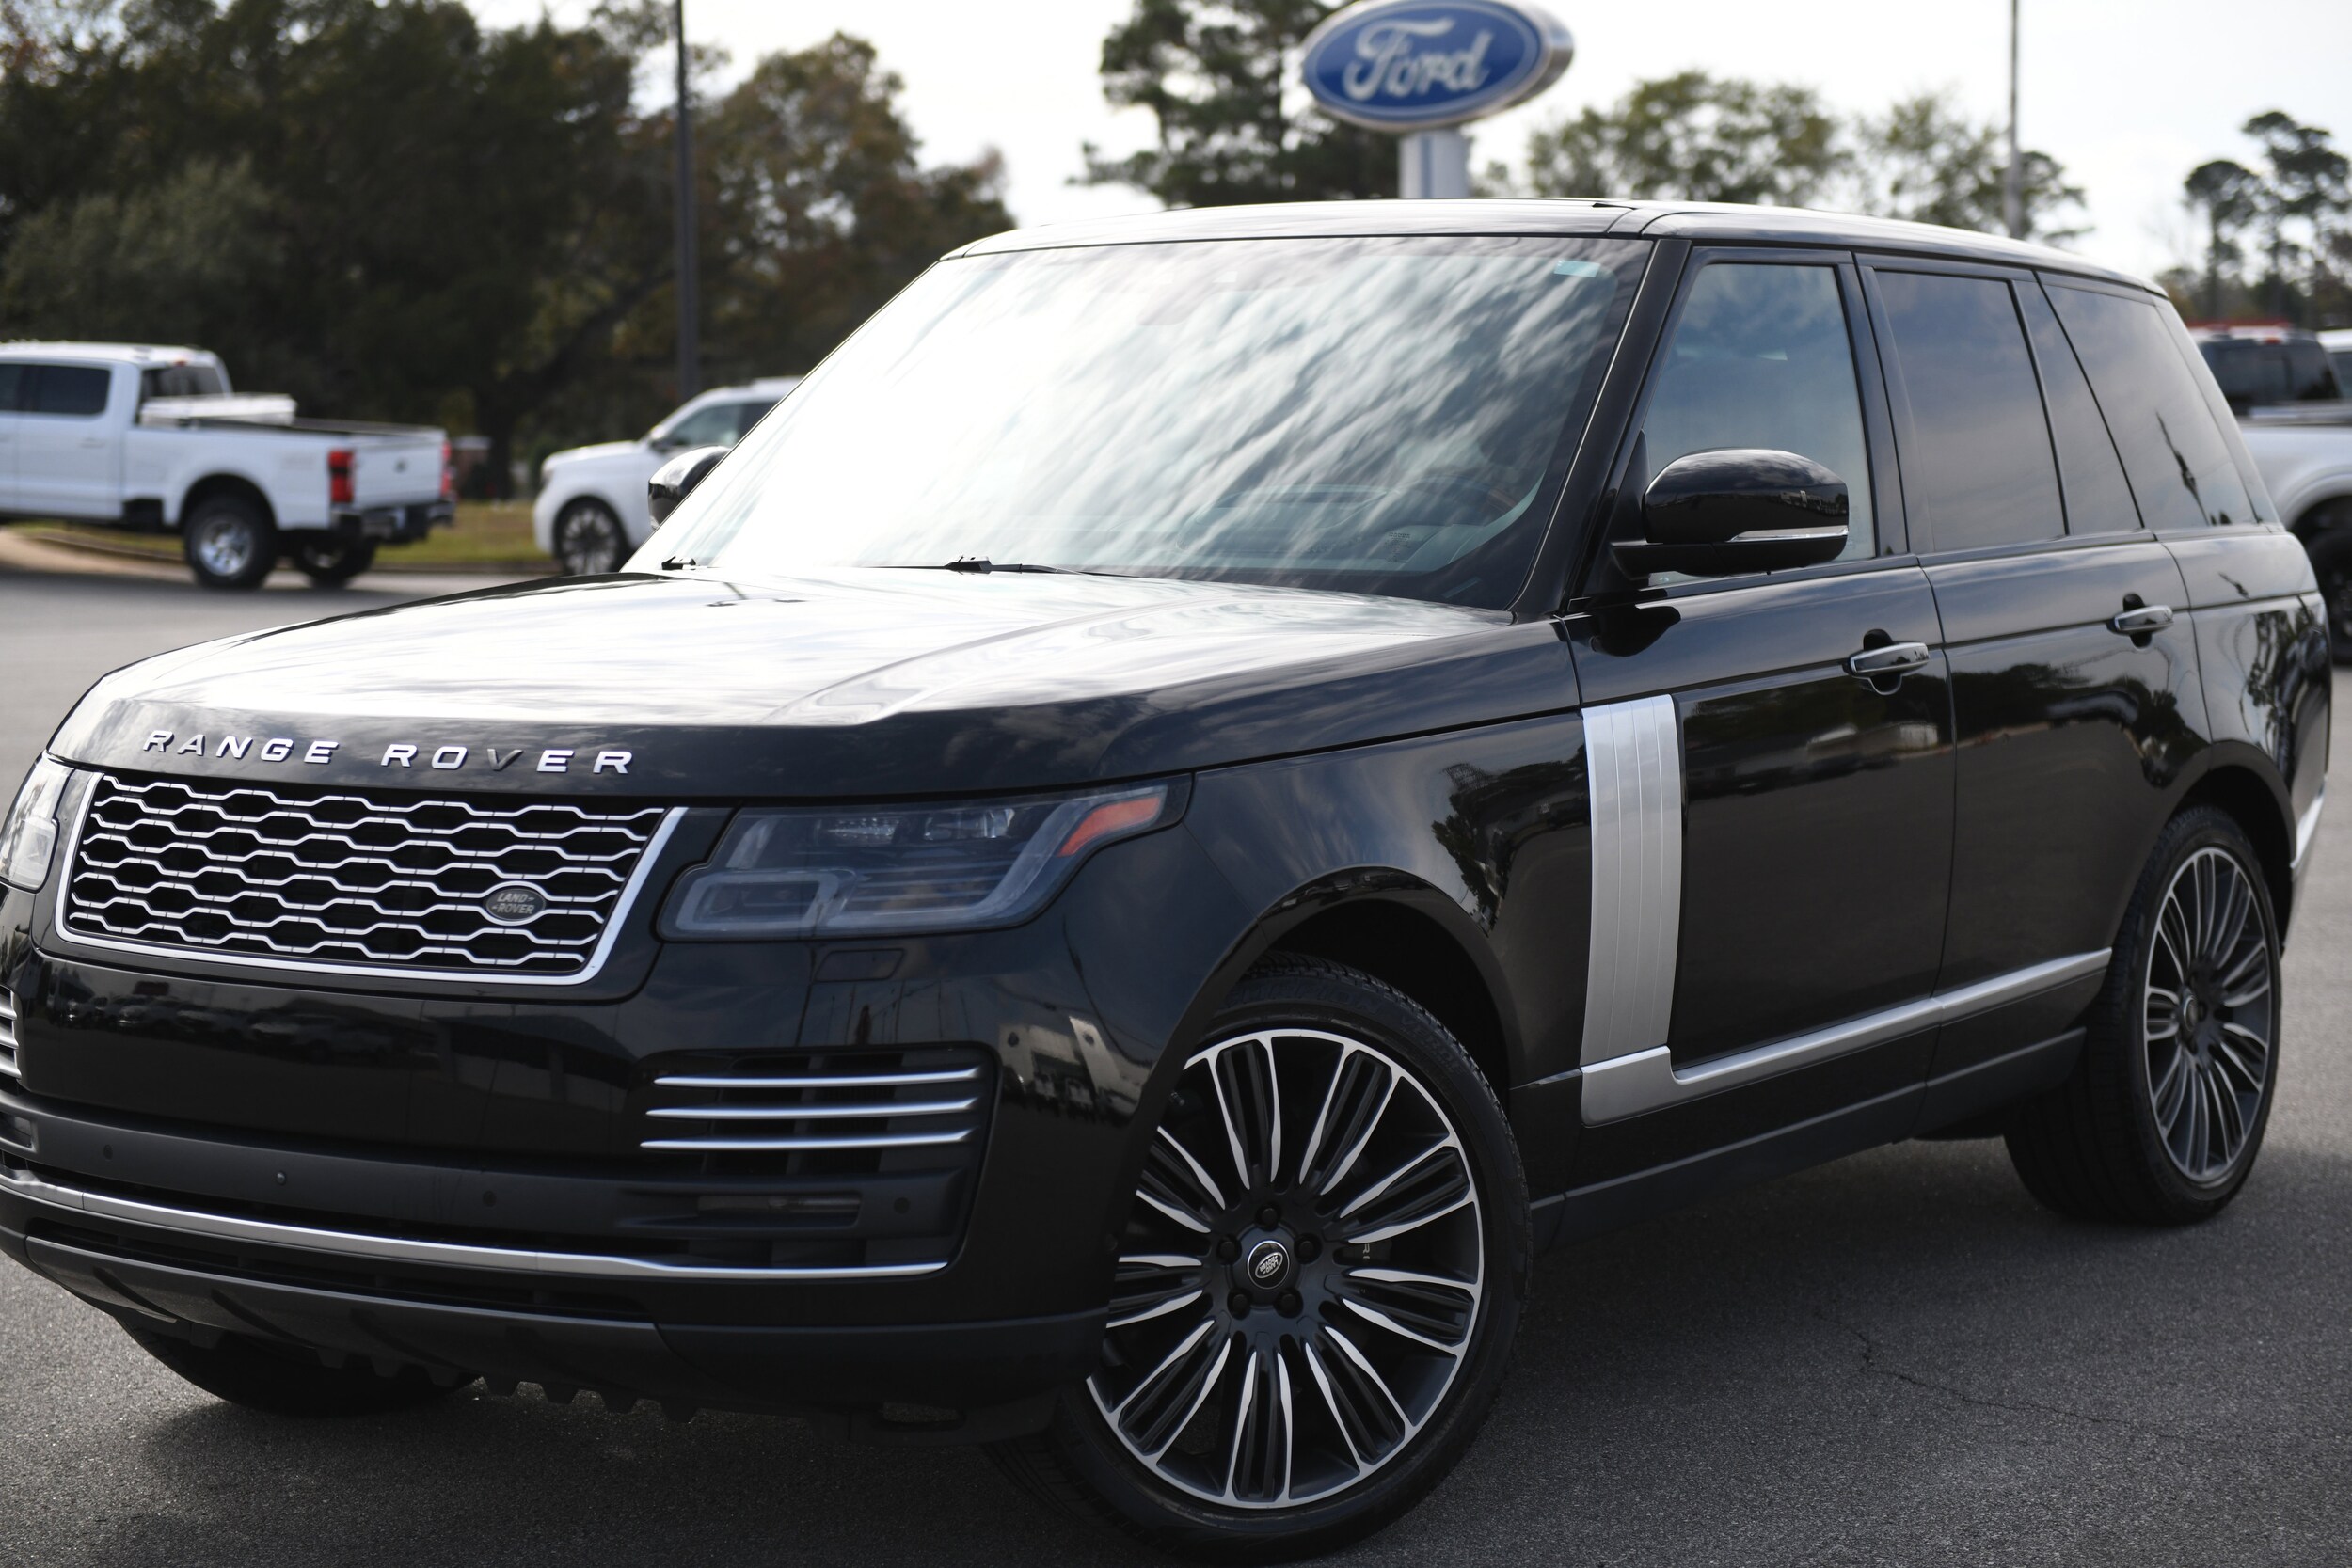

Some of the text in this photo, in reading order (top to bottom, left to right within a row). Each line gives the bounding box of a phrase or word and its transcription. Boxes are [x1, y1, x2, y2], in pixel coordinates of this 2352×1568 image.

[1343, 17, 1493, 100] Ford
[143, 730, 633, 774] RANGE ROVER
[497, 893, 528, 903] LAND
[497, 903, 534, 914] ROVER
